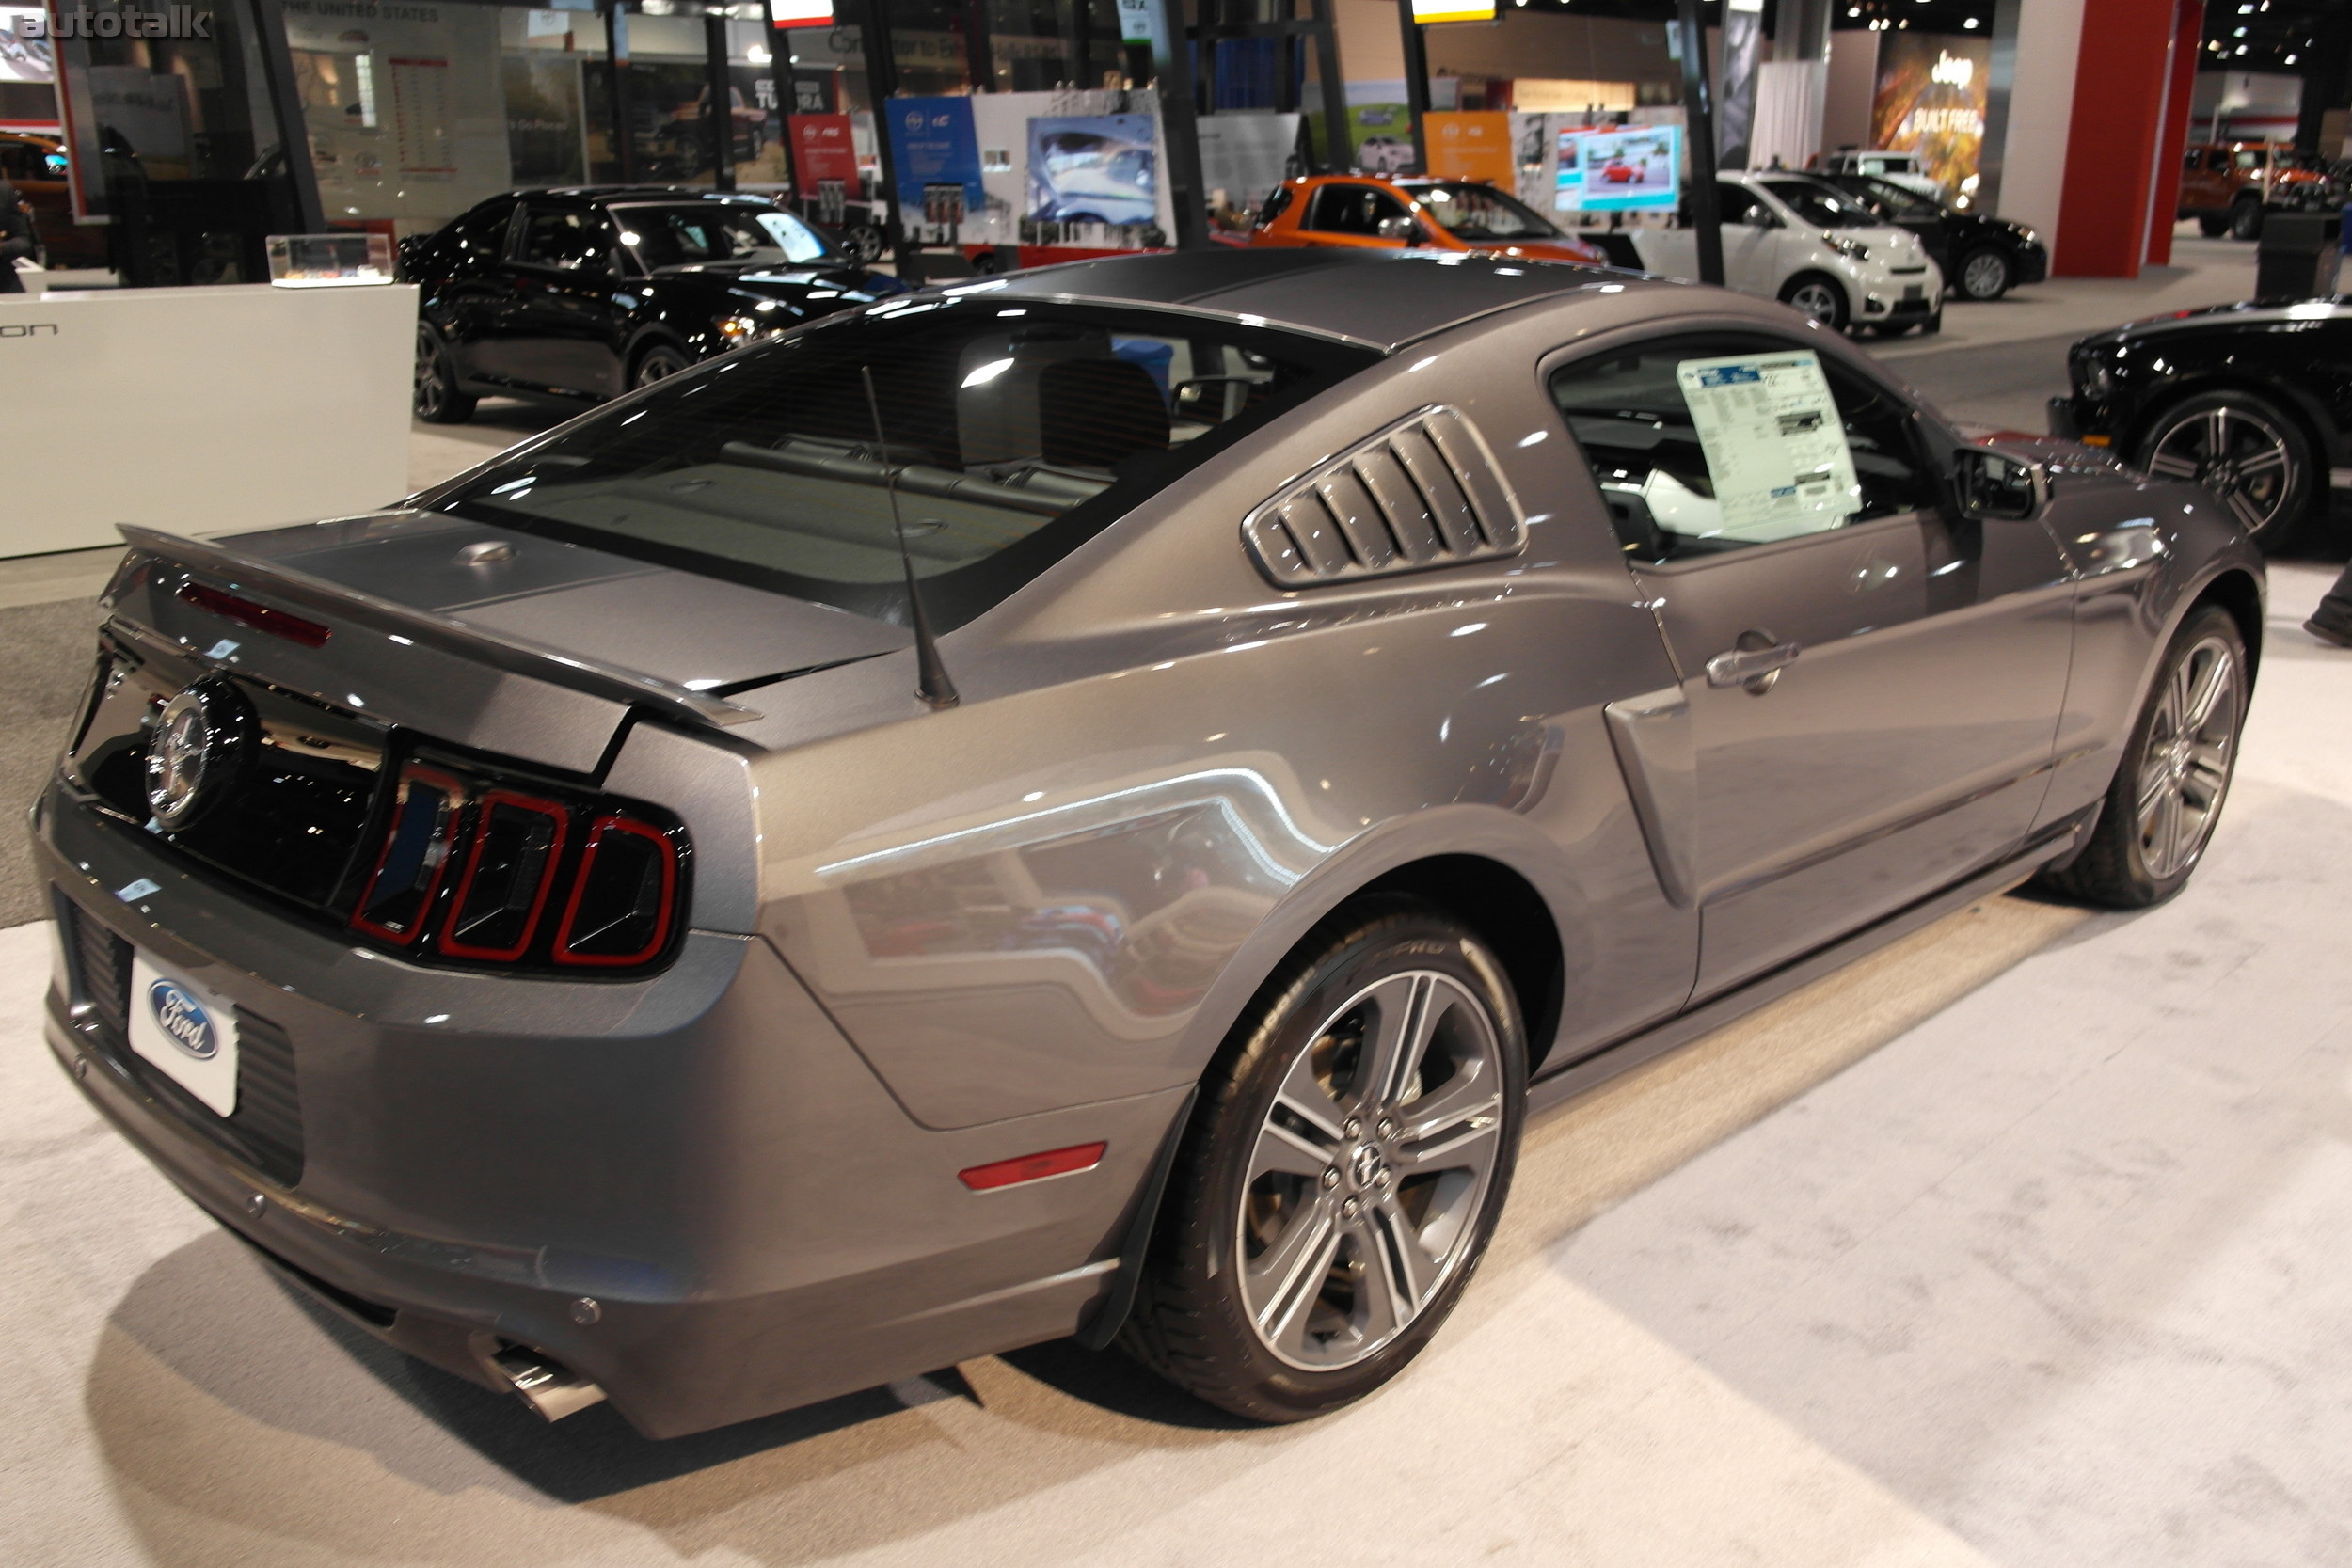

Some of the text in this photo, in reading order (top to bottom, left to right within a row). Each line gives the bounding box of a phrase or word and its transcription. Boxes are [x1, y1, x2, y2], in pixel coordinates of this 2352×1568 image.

[317, 3, 377, 18] UNITED
[382, 6, 438, 23] STATES
[1931, 49, 1973, 90] Jeep
[755, 92, 824, 110] TURA
[1913, 108, 1979, 133] BUILT FREE
[160, 989, 207, 1050] Ford
